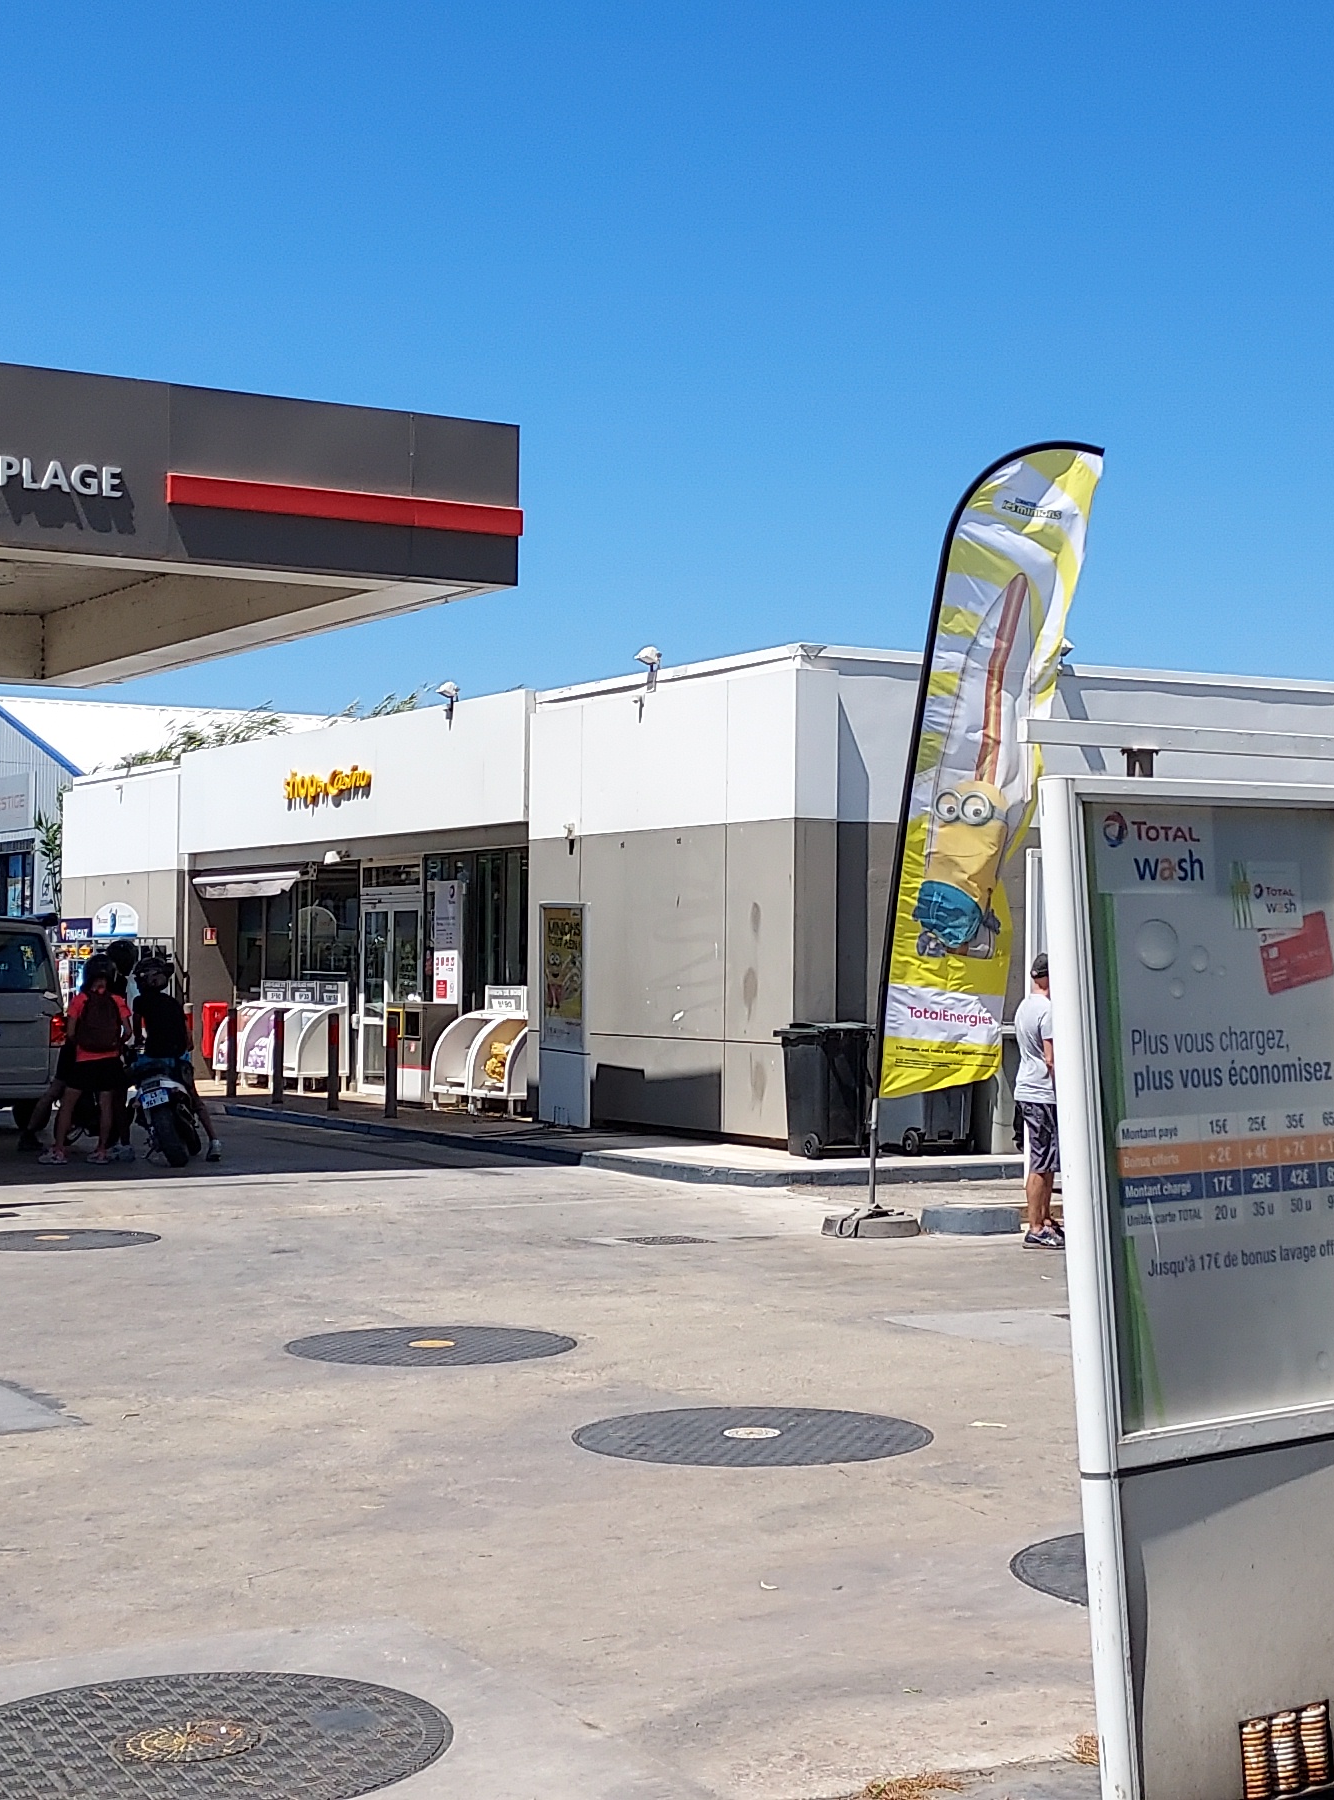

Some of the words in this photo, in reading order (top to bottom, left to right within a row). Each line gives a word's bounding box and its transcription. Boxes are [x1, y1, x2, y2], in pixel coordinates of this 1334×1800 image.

[1016, 504, 1063, 520] minions
[1130, 821, 1201, 843] TOTAL
[1133, 849, 1204, 881] wash
[907, 1006, 993, 1027] TotalEnergies
[1131, 1029, 1169, 1056] Plus
[1174, 1032, 1215, 1053] vous
[1219, 1026, 1290, 1056] chargez,
[1134, 1065, 1174, 1098] plus
[1179, 1067, 1223, 1089] vous
[1228, 1057, 1332, 1087] économisez
[1209, 1118, 1229, 1134] 15€
[1247, 1116, 1266, 1132] 25€
[1285, 1113, 1305, 1129] 35€
[1122, 1127, 1157, 1140] Montant
[1158, 1126, 1178, 1140] payé
[1213, 1176, 1233, 1193] 17€
[1251, 1172, 1272, 1189] 29€
[1290, 1169, 1309, 1185] 42€
[1125, 1184, 1161, 1198] Montant
[1162, 1180, 1191, 1196] chargé
[1214, 1205, 1228, 1220] 20
[1230, 1207, 1237, 1219] u
[1253, 1201, 1265, 1216] 35
[1268, 1203, 1274, 1215] u
[1290, 1198, 1303, 1213] 50
[1305, 1200, 1312, 1211] u
[1178, 1209, 1202, 1221] TOTAL
[1148, 1257, 1196, 1278] Jusqu'à
[1199, 1251, 1221, 1271] 17€
[1224, 1251, 1238, 1268] de
[1241, 1248, 1277, 1266] bonus
[1279, 1244, 1316, 1263] lavage
